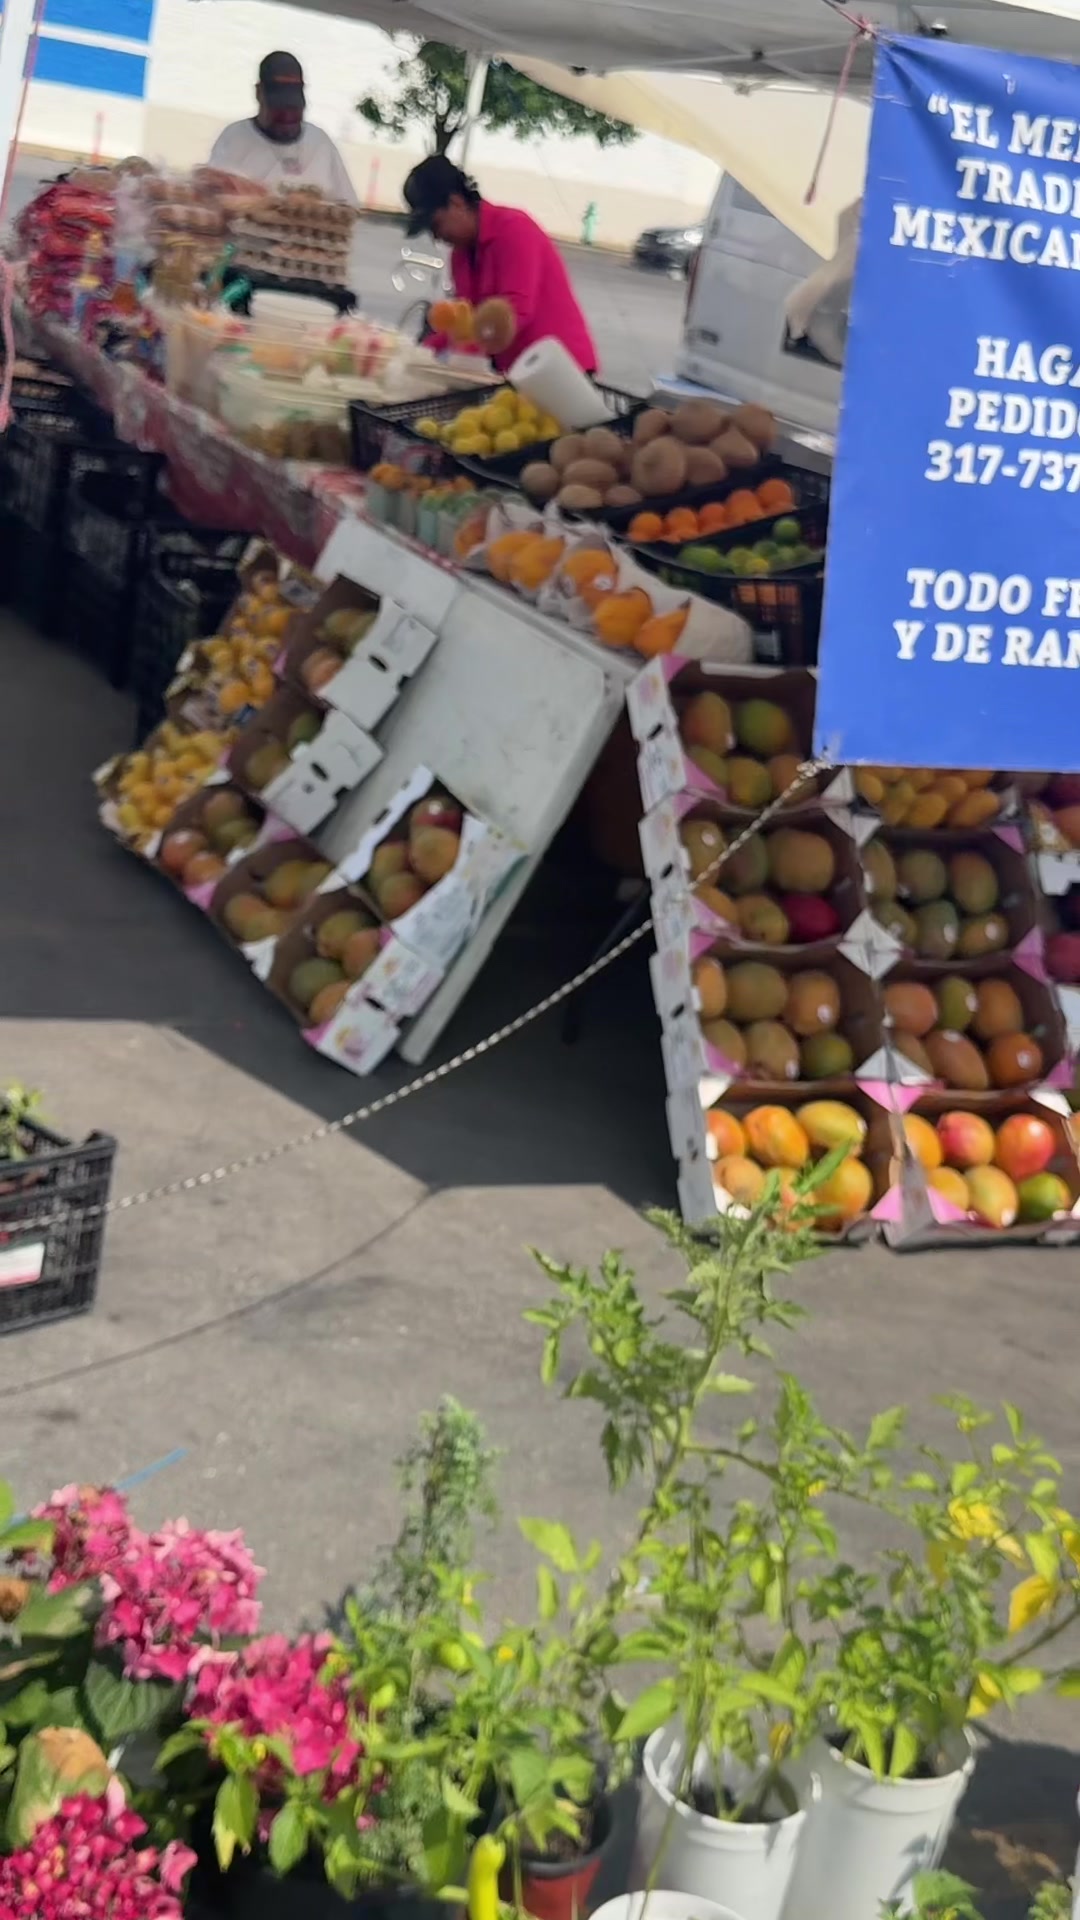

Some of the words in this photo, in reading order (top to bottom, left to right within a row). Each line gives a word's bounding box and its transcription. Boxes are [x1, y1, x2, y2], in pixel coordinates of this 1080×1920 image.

[1008, 113, 1080, 163] ME
[945, 388, 1080, 440] PEDID
[924, 440, 1080, 493] 317-737
[906, 568, 1032, 615] TODO
[893, 620, 925, 660] Y
[931, 623, 993, 664] DE
